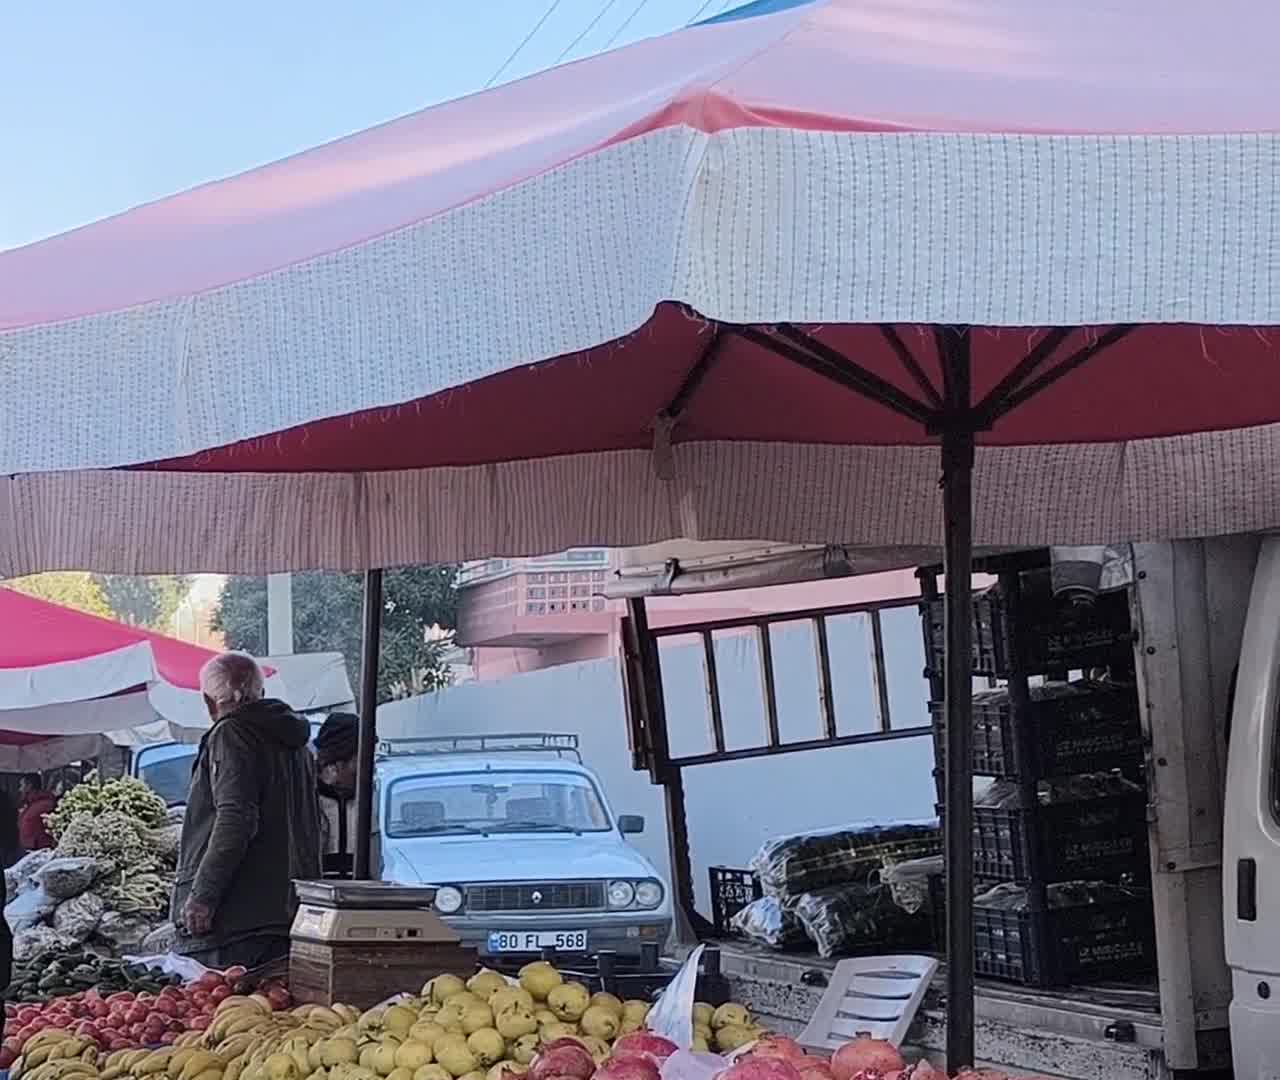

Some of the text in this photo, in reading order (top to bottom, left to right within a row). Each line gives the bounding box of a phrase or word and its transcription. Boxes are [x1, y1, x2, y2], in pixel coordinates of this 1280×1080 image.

[500, 933, 584, 949] 80 FL 568
